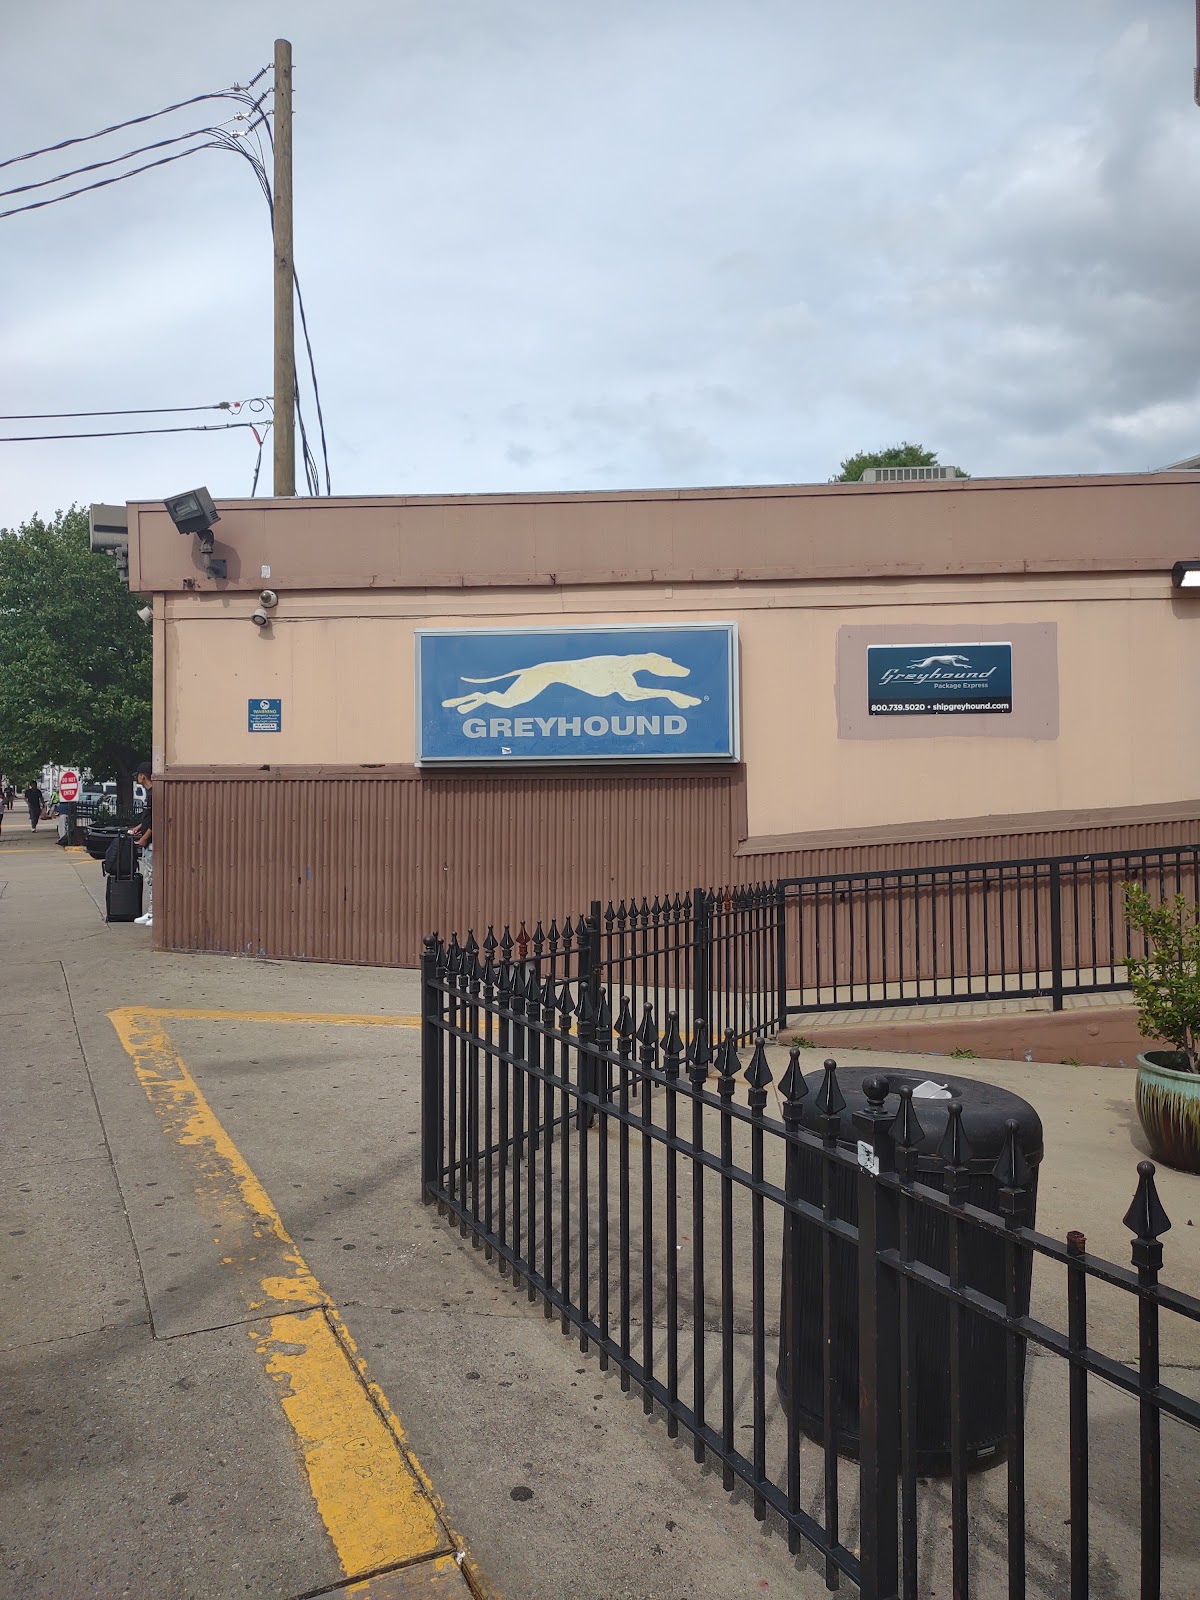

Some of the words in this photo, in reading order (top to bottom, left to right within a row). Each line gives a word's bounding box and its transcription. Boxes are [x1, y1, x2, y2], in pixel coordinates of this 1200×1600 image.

[879, 667, 997, 685] Greyhound
[933, 702, 1009, 711] shipgreyhound.com
[462, 715, 688, 738] GREYHOUND
